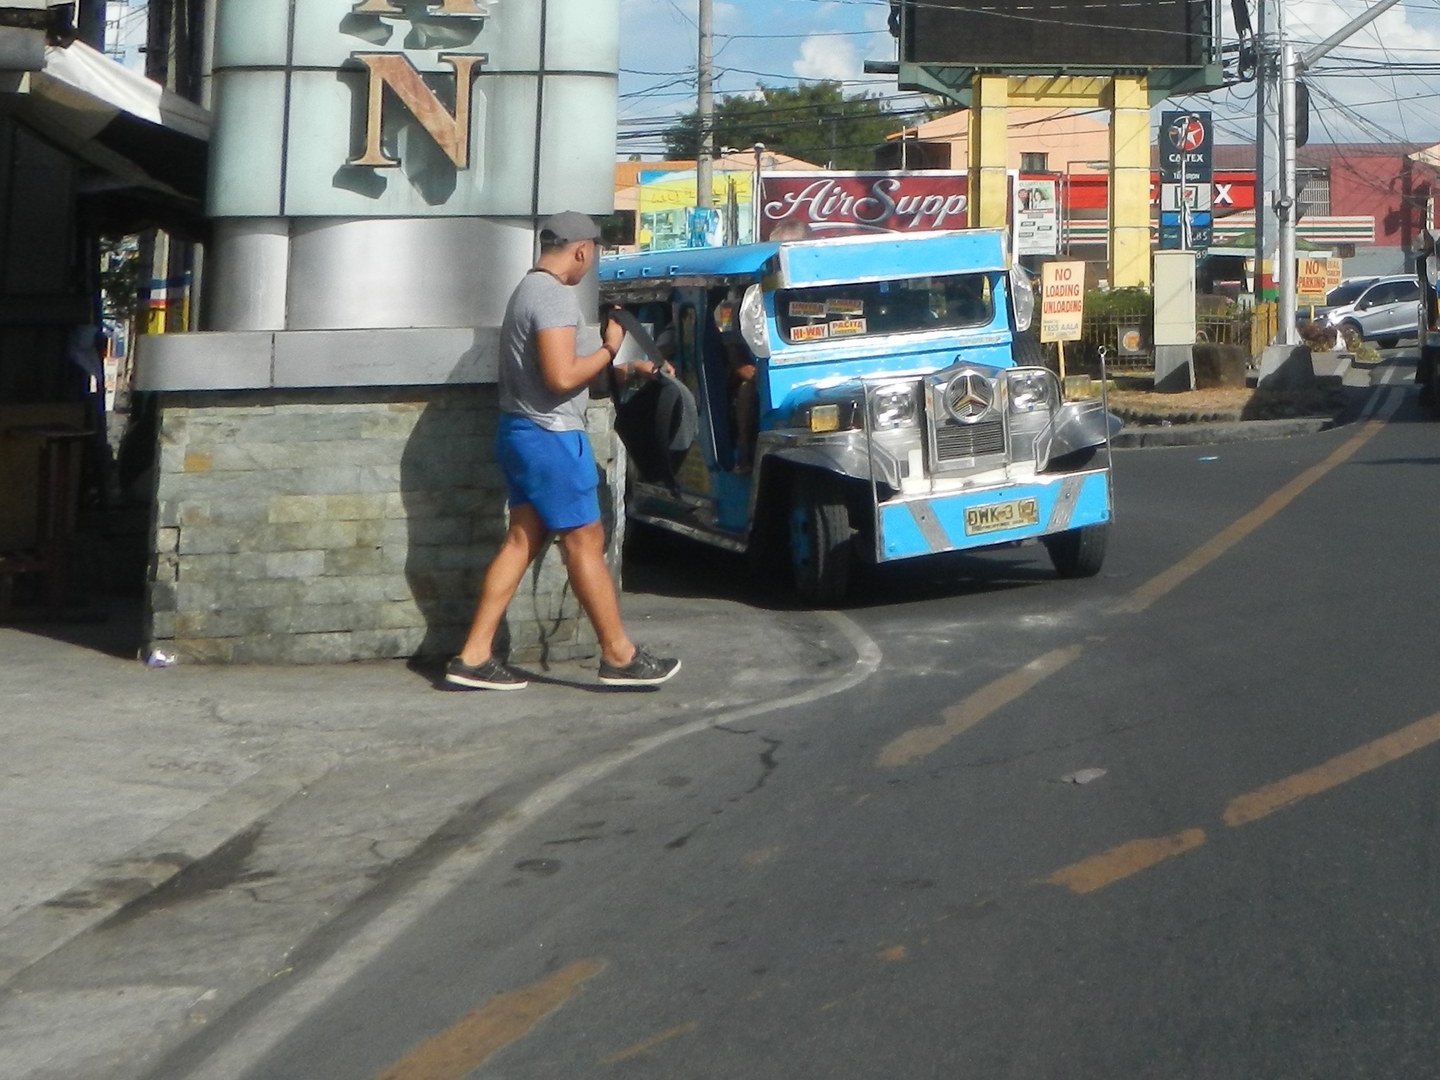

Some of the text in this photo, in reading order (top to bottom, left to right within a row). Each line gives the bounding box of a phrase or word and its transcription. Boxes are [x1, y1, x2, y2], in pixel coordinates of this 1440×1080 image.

[764, 178, 854, 222] Air
[1055, 268, 1072, 281] NO
[1306, 261, 1320, 275] NO
[1299, 277, 1326, 289] PARKING
[1045, 284, 1080, 298] LOADING
[1043, 300, 1082, 314] UNLOADING
[793, 325, 826, 340] HI-WAY
